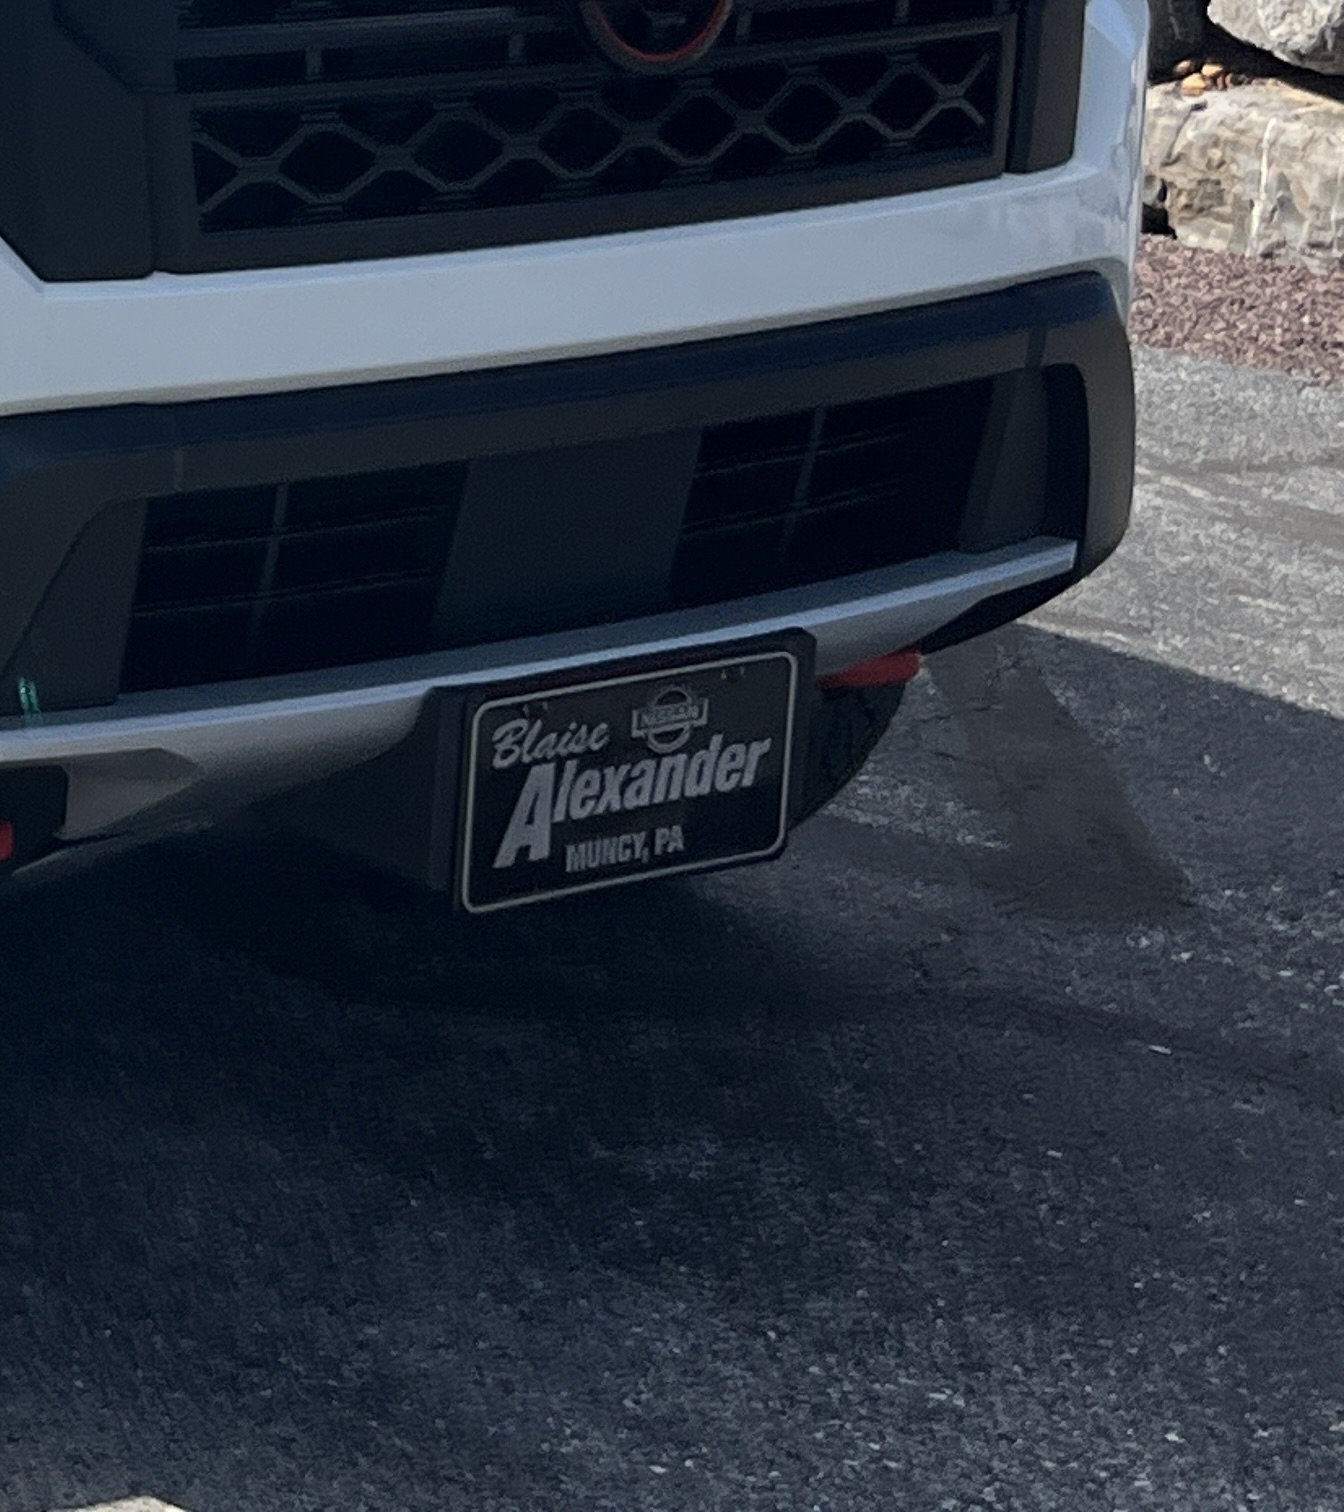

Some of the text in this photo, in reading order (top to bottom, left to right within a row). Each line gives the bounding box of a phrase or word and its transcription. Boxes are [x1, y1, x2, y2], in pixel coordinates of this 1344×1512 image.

[491, 717, 611, 769] Blaise
[492, 734, 772, 870] Alexander
[565, 824, 685, 874] MUNCY, PA
